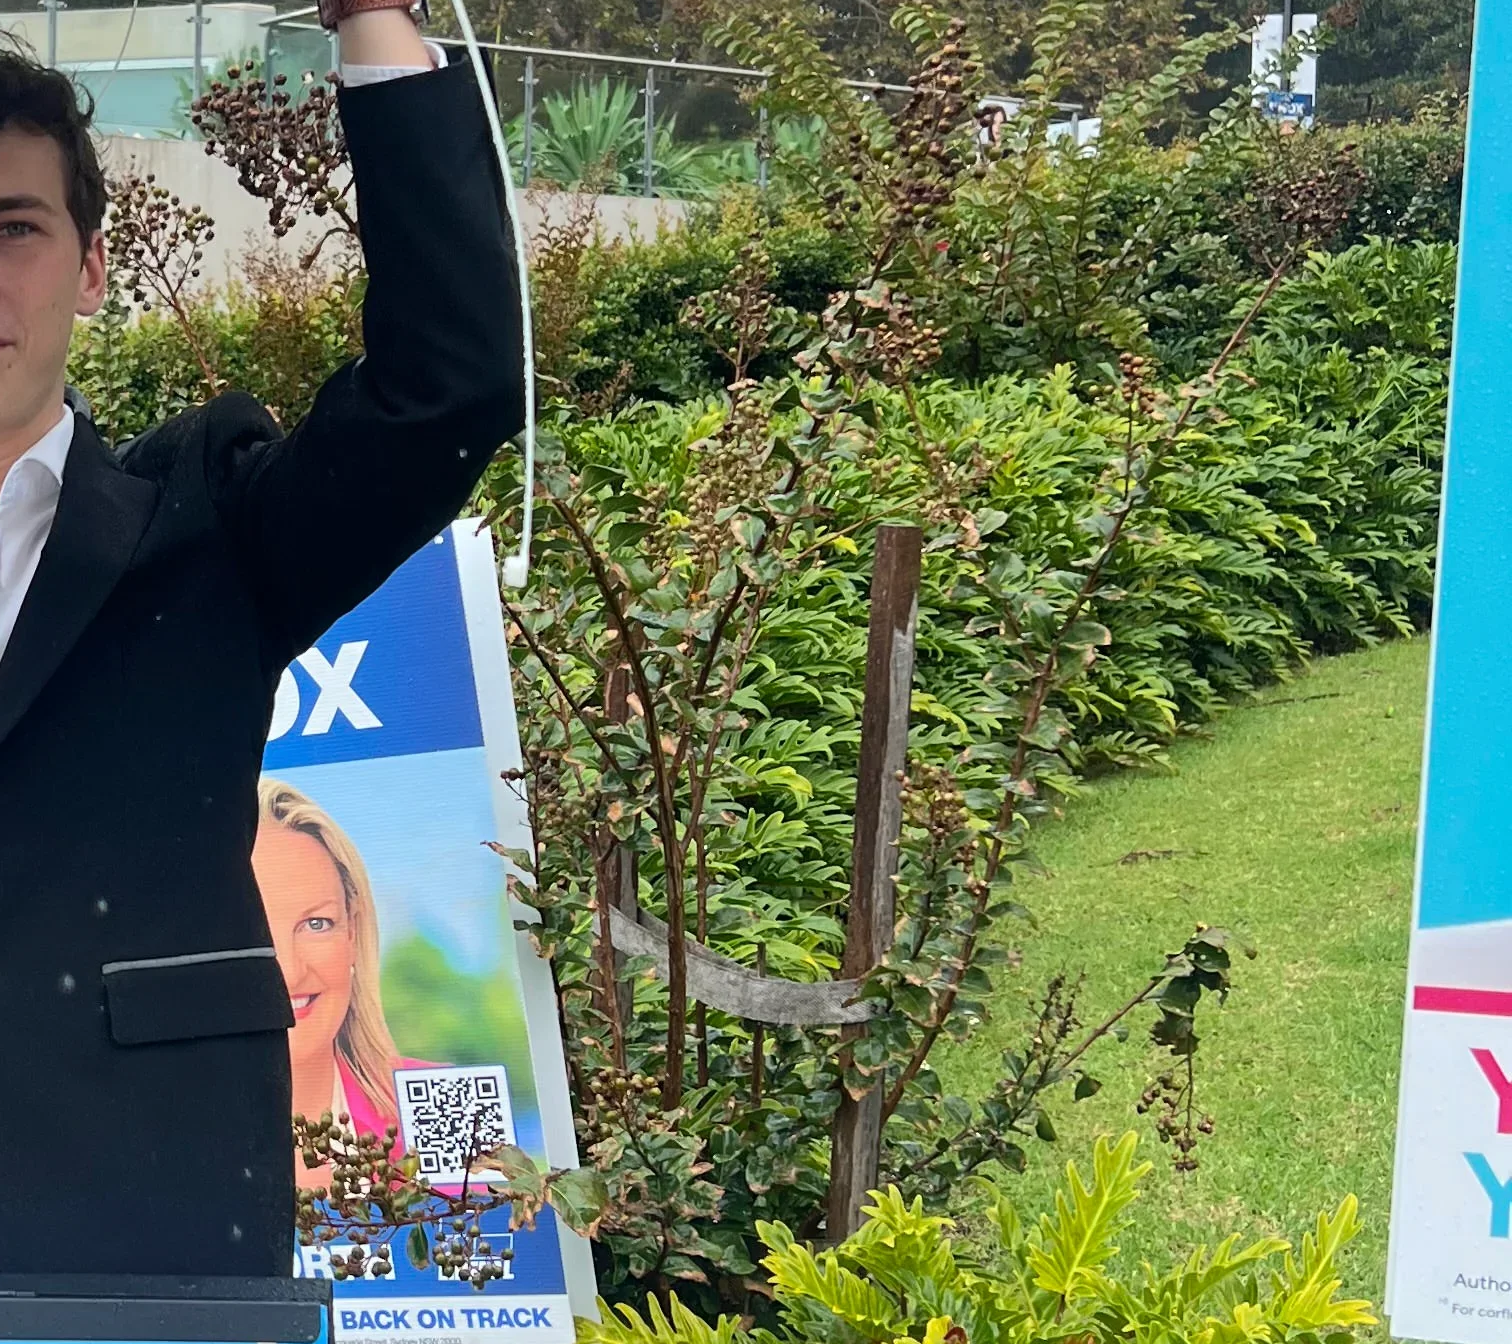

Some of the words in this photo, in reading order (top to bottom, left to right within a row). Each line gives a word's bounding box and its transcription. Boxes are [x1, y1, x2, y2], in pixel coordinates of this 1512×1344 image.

[1452, 1303, 1474, 1315] For
[341, 1310, 411, 1330] BACK
[417, 1309, 455, 1329] ON
[460, 1307, 552, 1329] TRACK
